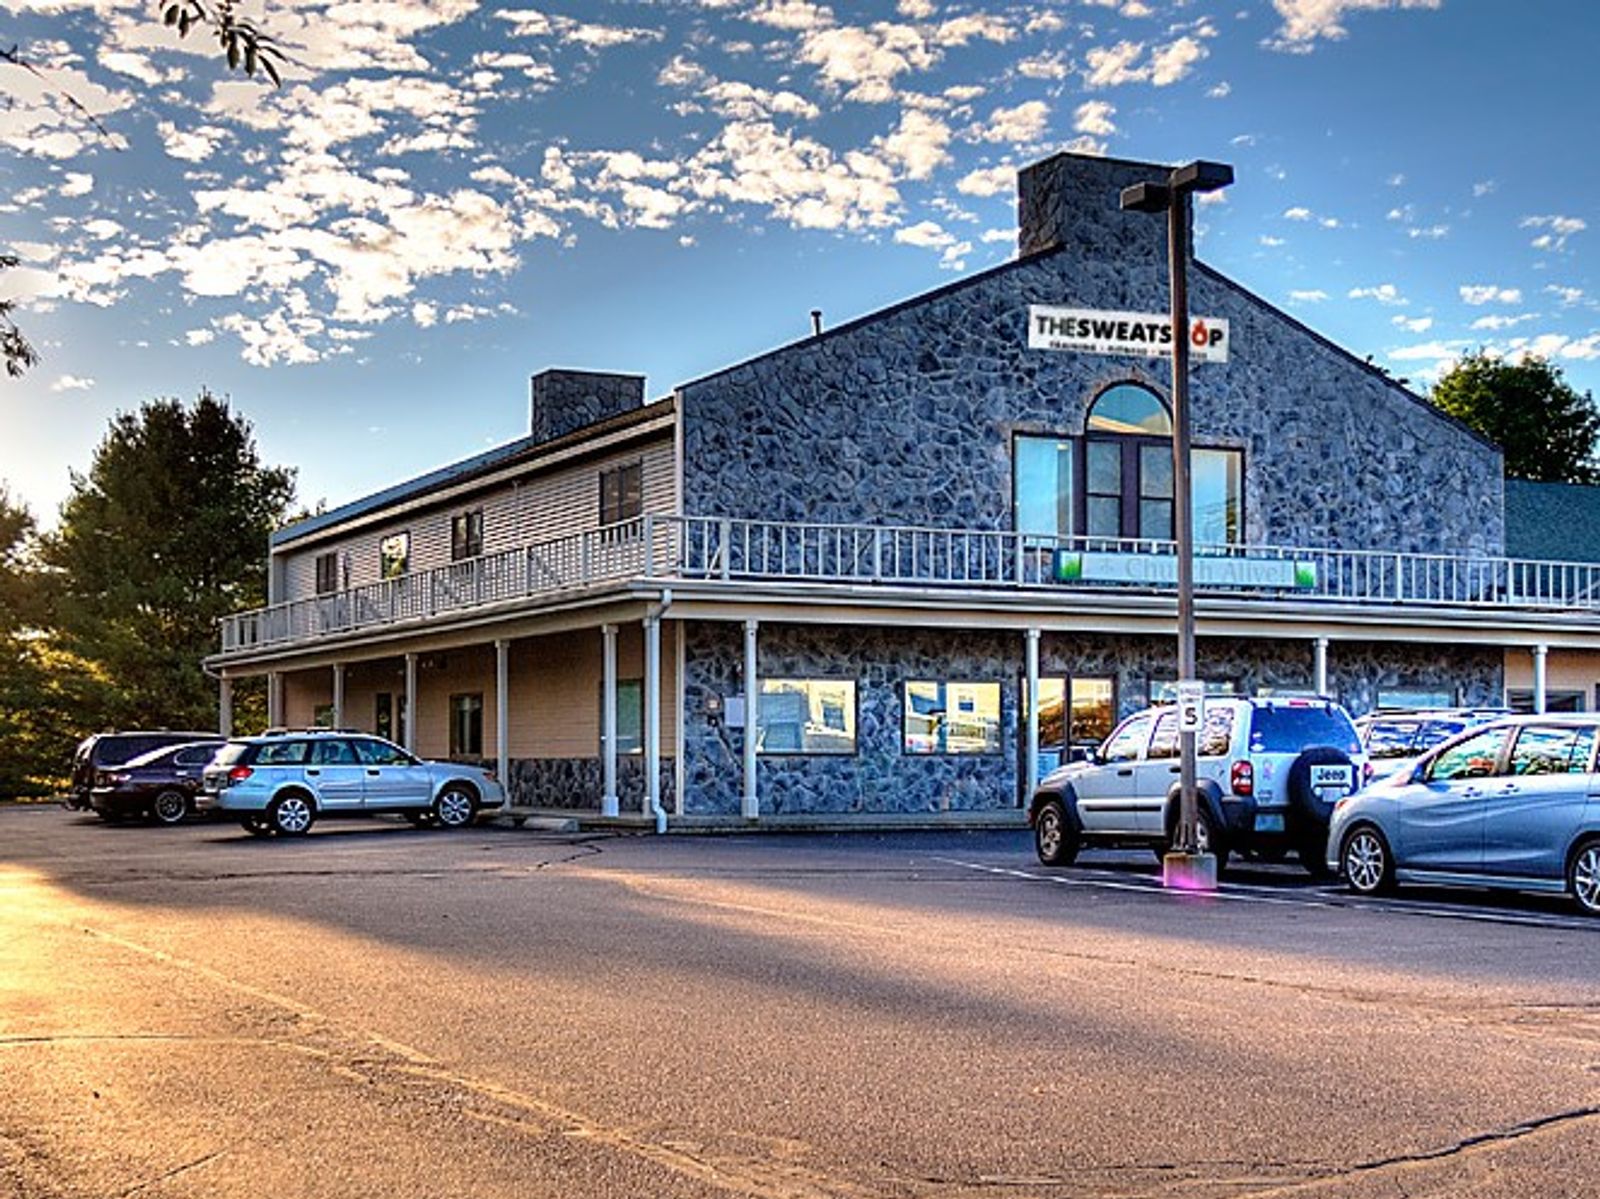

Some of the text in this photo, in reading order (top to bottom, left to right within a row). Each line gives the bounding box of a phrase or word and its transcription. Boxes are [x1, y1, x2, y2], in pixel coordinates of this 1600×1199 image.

[1036, 315, 1223, 348] THESWEATSOP
[1125, 558, 1213, 580] Chuh
[1185, 707, 1198, 725] 5
[1317, 768, 1346, 780] Jeep
